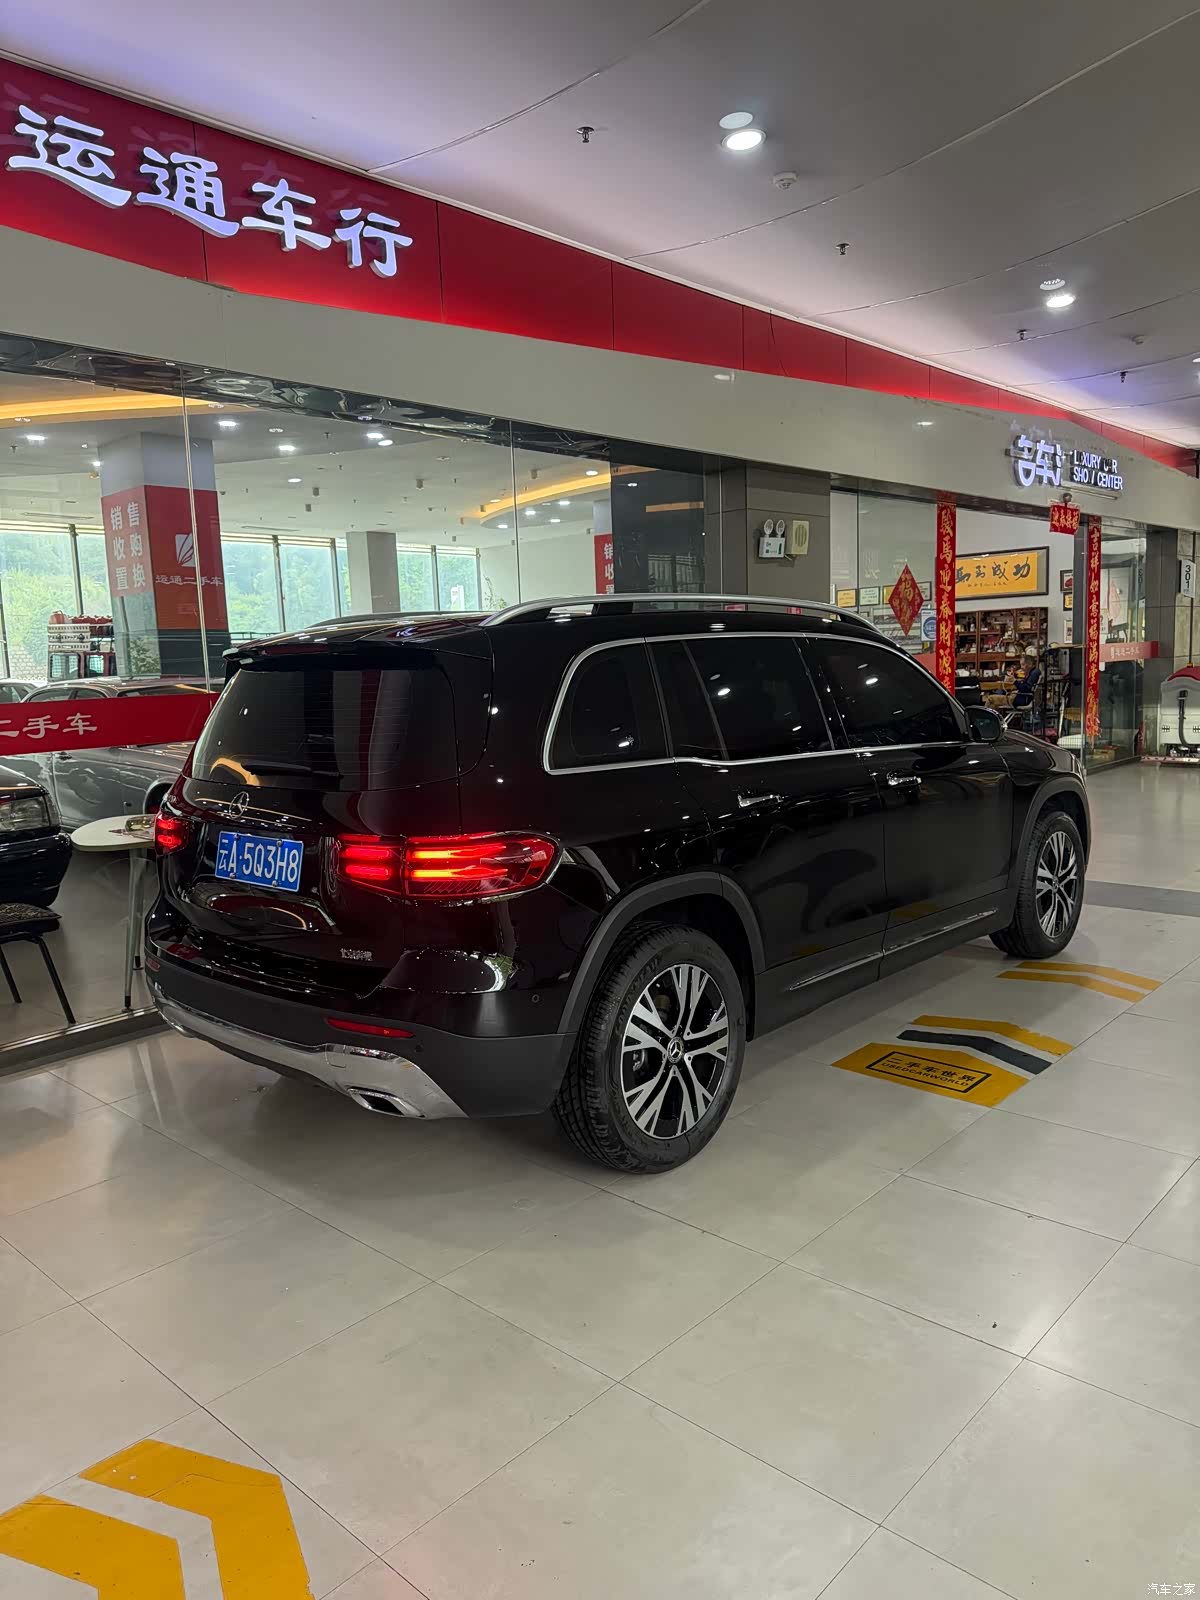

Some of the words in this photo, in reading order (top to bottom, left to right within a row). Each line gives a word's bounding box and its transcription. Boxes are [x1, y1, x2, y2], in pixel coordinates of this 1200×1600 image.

[6, 104, 413, 278] 运通车行
[1097, 471, 1123, 490] CENTER
[110, 501, 140, 531] 销售
[112, 533, 143, 561] 收购
[115, 562, 146, 590] 置换
[155, 574, 224, 587] 运通二手车
[881, 1062, 969, 1087] USEDCARWORLD
[886, 1057, 977, 1082] 二手车世界
